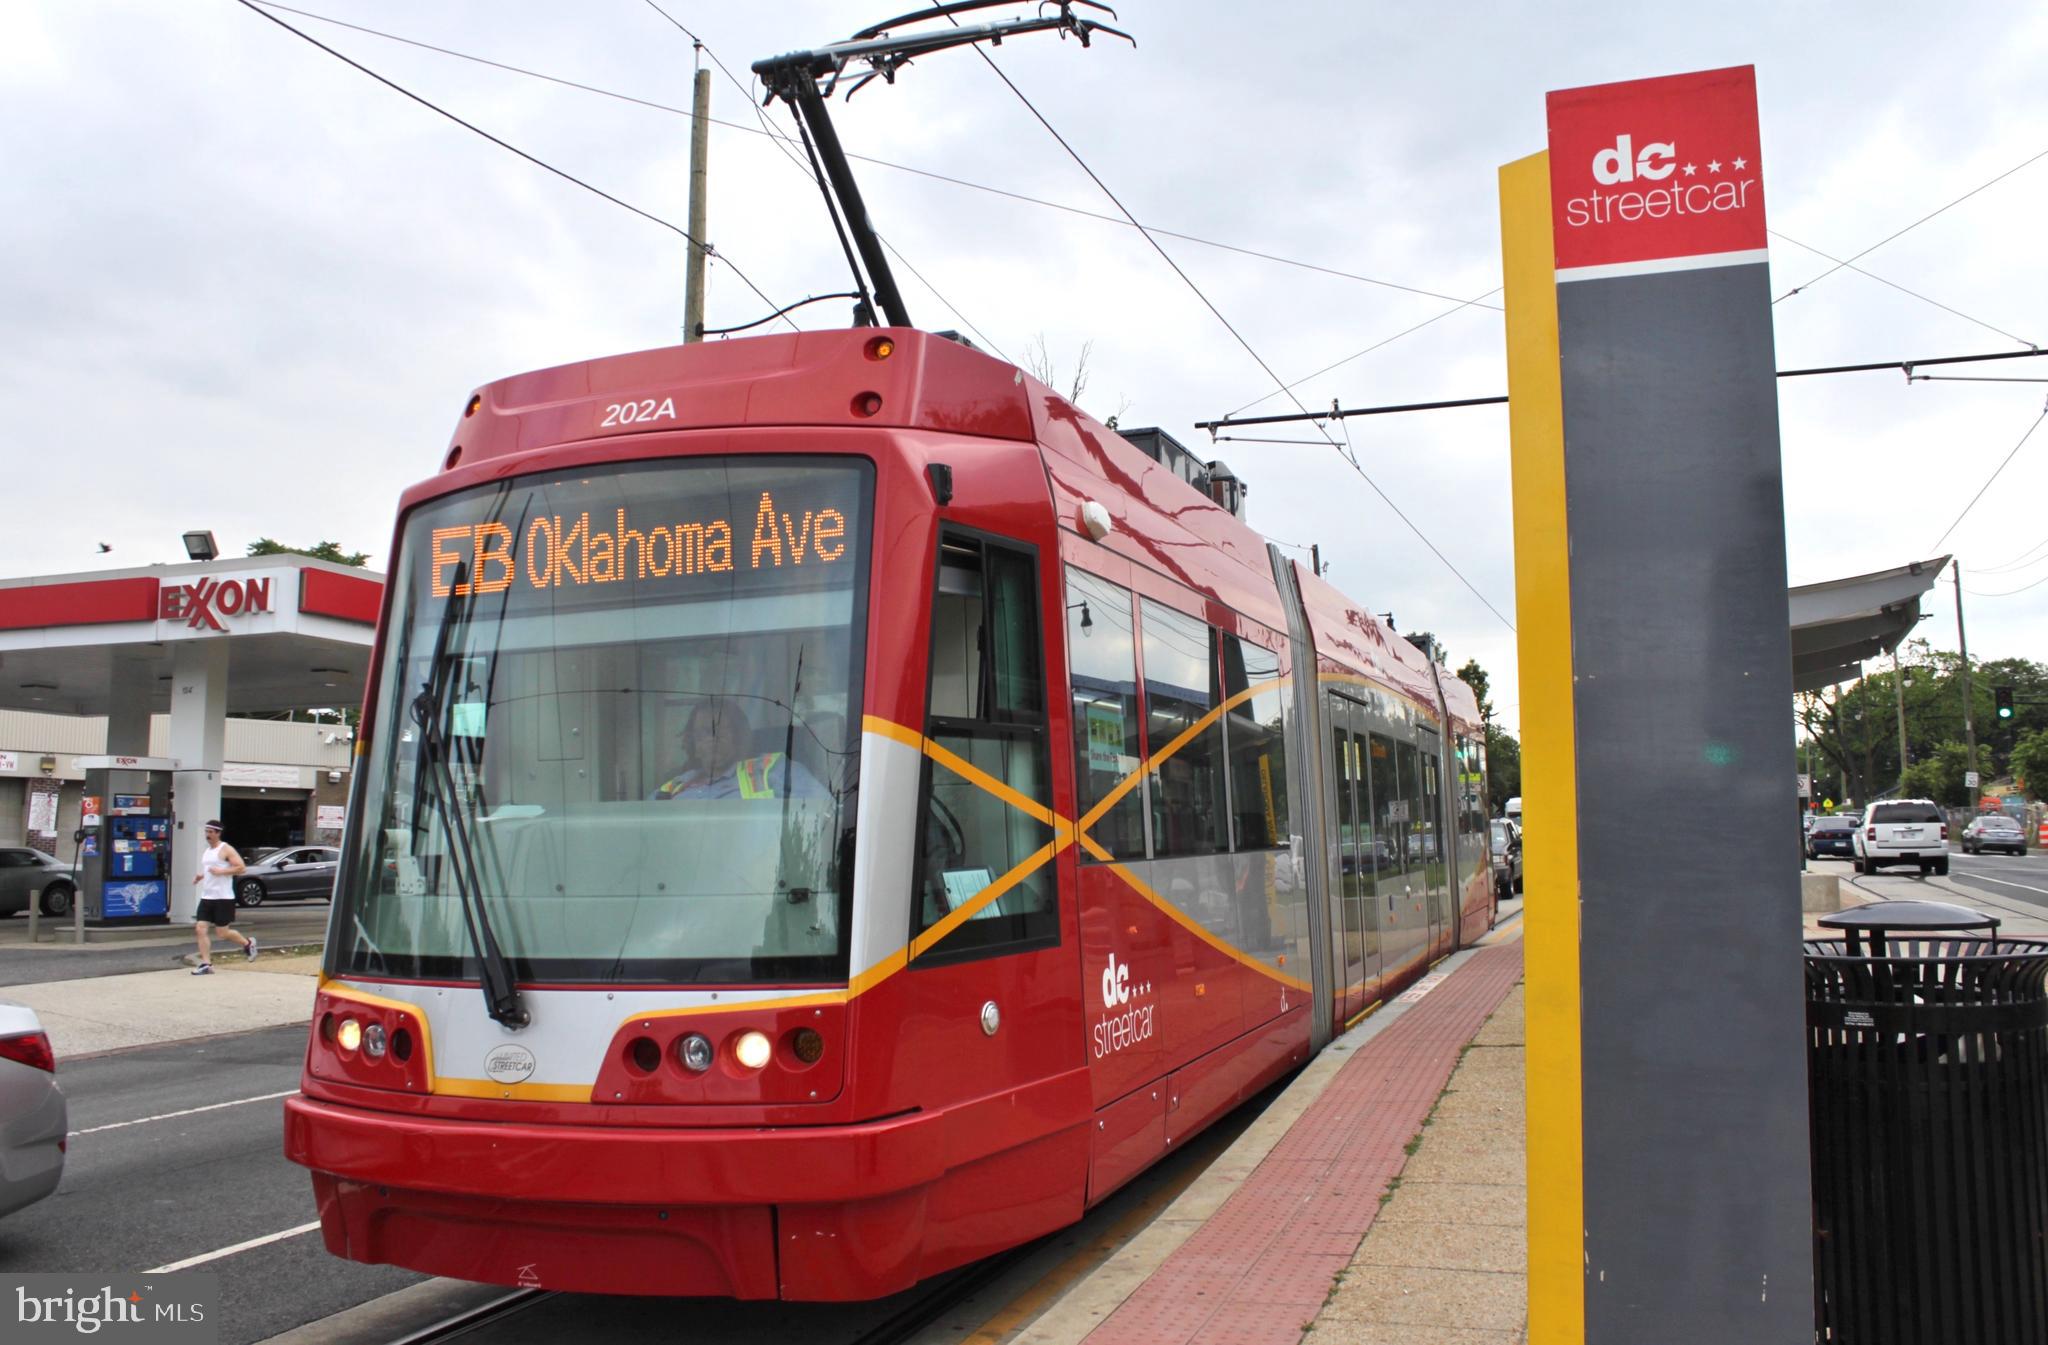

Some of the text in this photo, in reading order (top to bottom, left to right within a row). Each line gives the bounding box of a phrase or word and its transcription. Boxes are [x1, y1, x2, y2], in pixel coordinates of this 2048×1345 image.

[1592, 134, 1676, 185] dc
[1567, 179, 1755, 226] streetcar
[600, 397, 676, 427] 202A
[432, 521, 515, 598] EB
[752, 491, 844, 567] Ave
[160, 577, 272, 631] EXXON
[116, 757, 137, 766] EXXON
[1103, 952, 1130, 1008] dc
[1094, 1003, 1154, 1059] streetcar
[492, 1061, 533, 1072] STREETCAR
